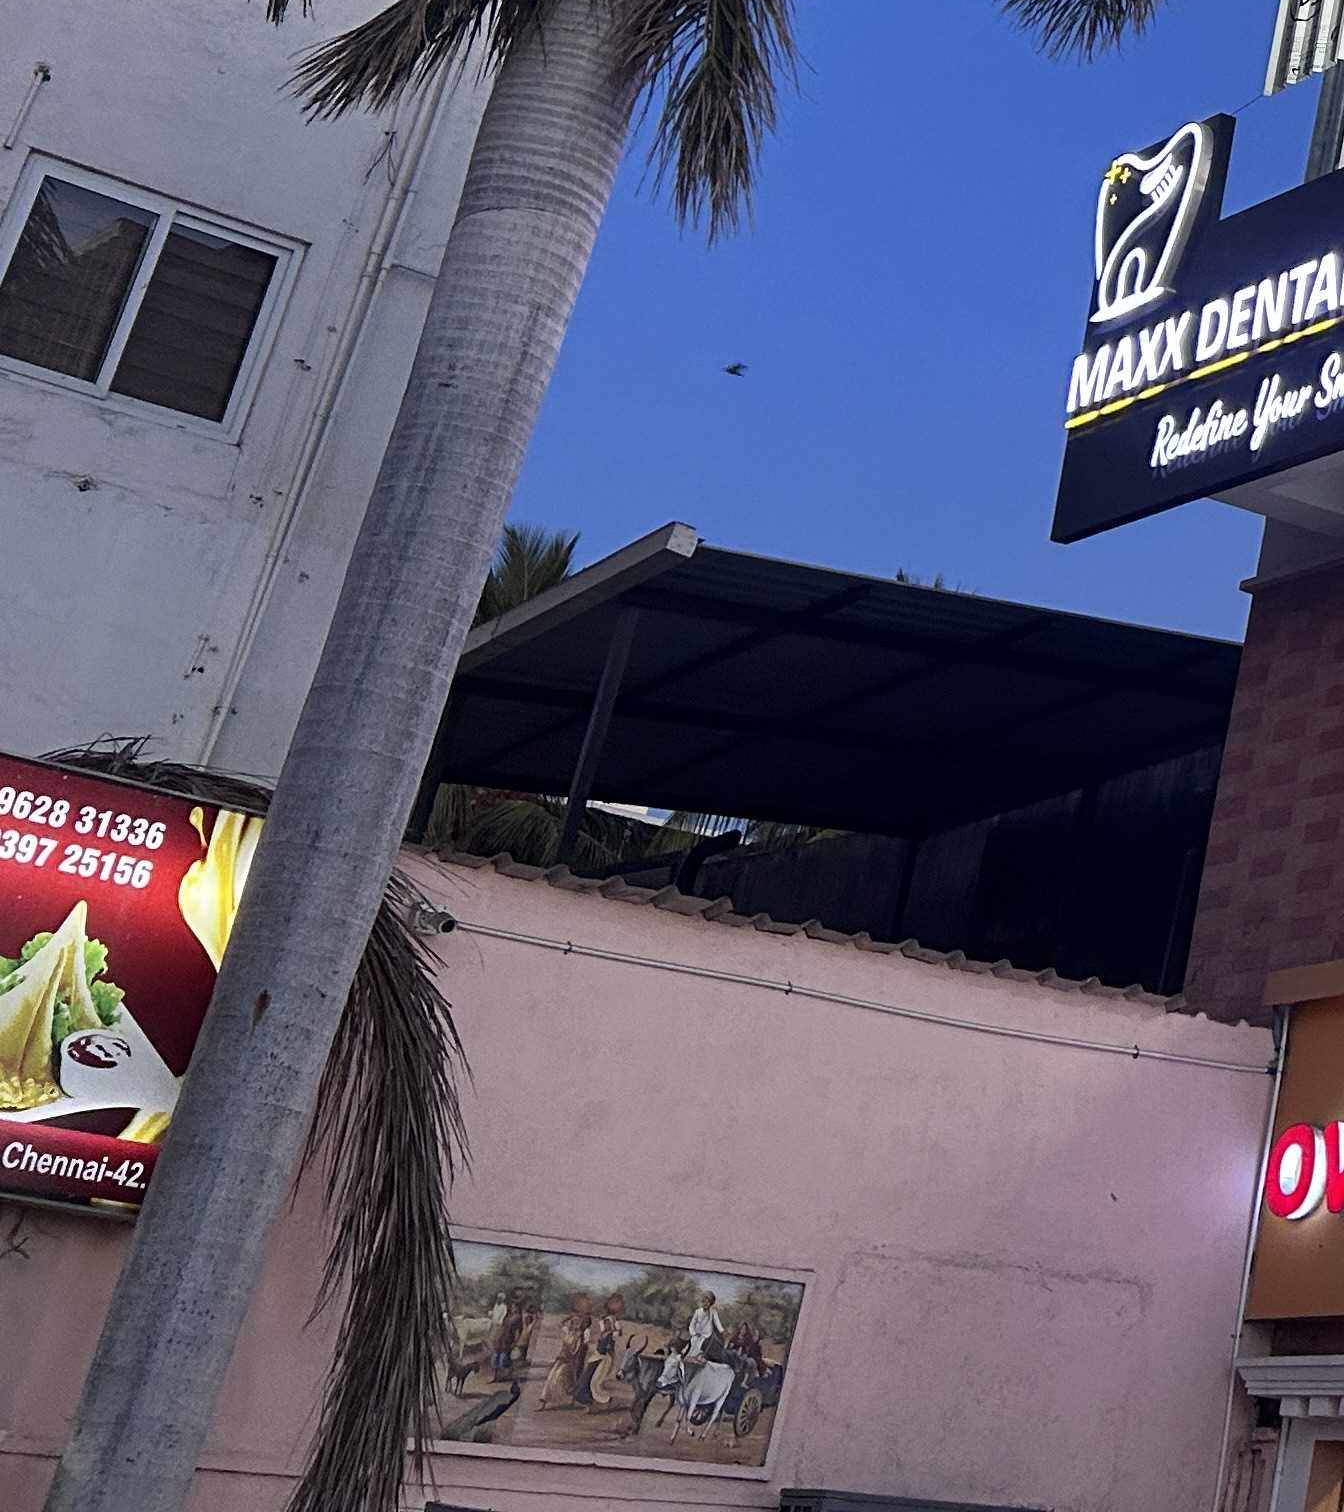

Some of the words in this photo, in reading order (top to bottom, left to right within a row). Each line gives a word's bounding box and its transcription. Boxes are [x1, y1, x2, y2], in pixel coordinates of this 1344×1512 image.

[1067, 312, 1190, 414] MAXX
[1151, 404, 1247, 469] Redefine
[1251, 377, 1312, 452] Your
[0, 787, 70, 828] 9628
[75, 806, 166, 850] 31336
[0, 830, 58, 867] 397
[58, 844, 153, 888] 25156
[2, 1140, 147, 1190] Chennai-42.
